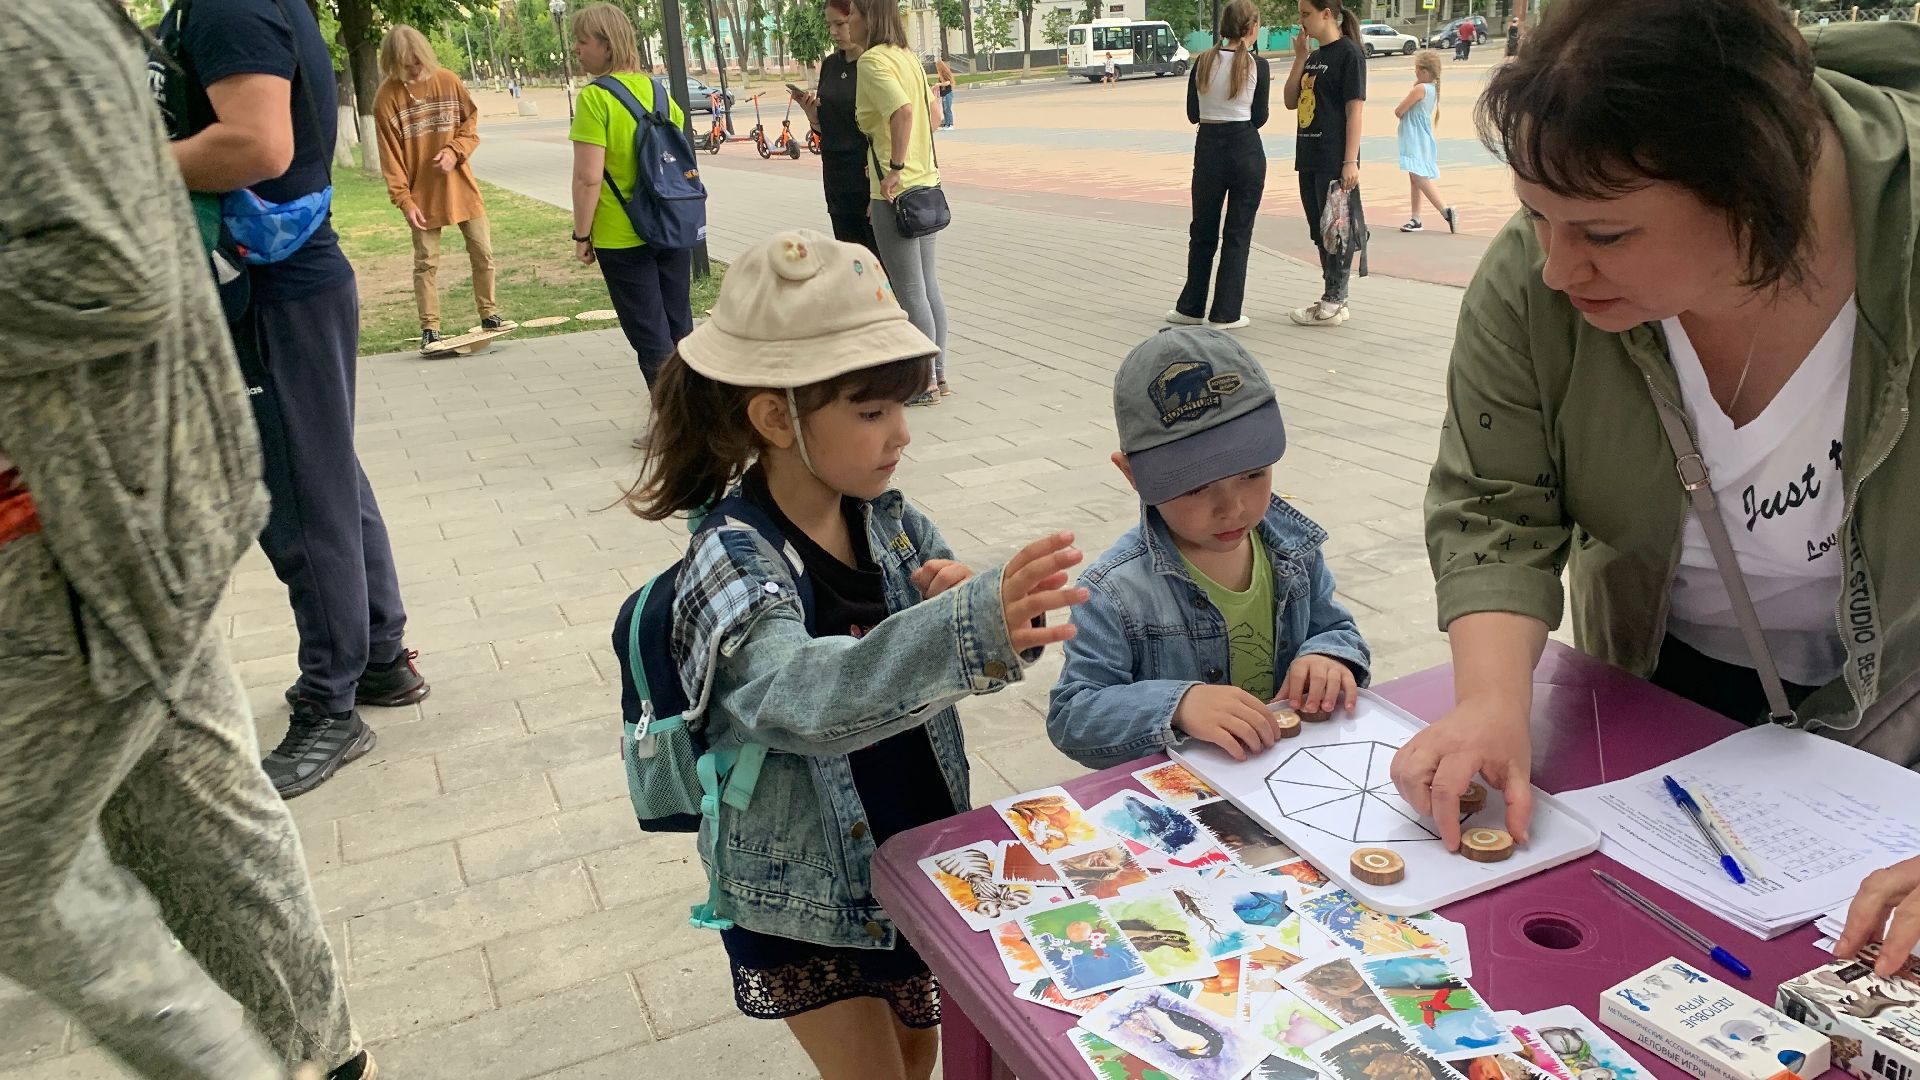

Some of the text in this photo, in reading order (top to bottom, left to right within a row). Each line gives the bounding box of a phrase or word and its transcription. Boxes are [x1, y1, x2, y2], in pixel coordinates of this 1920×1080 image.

[1479, 412, 1493, 431] Q
[1742, 462, 1821, 532] Just
[1456, 518, 1470, 533] Y
[1474, 552, 1487, 565] Y
[1849, 571, 1875, 643] STUDIO
[1674, 994, 1708, 1015] ИГРЫ
[1680, 996, 1734, 1029] ДЕЛОВЫЕ
[1637, 1033, 1707, 1078] ДЕЛОВЫЕ ИГРЫ
